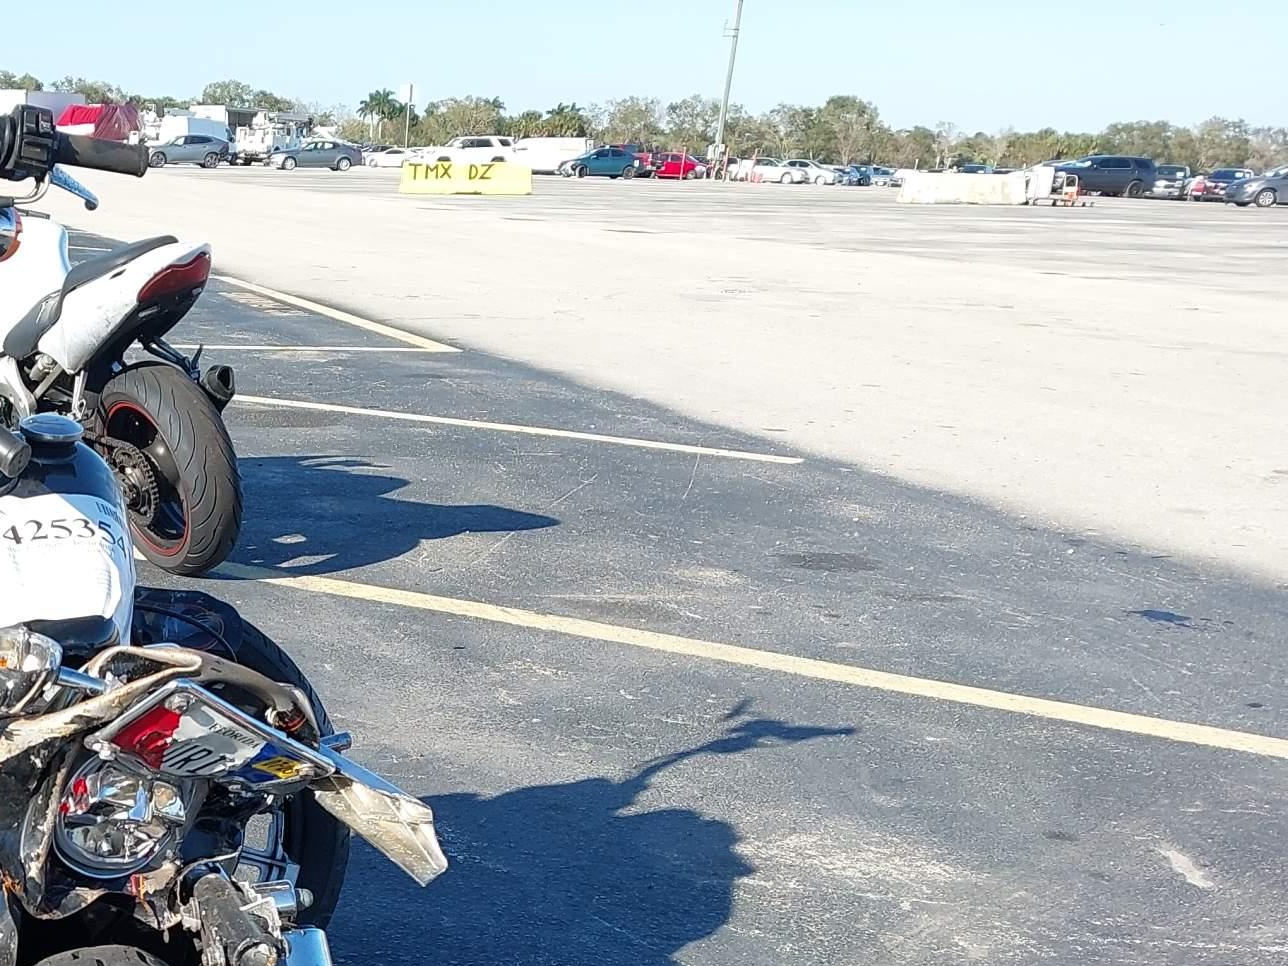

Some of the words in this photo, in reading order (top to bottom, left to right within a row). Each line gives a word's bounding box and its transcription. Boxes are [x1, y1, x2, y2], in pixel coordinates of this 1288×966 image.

[408, 162, 452, 181] TMX
[468, 162, 496, 181] DZ
[208, 722, 261, 750] FLORIDA
